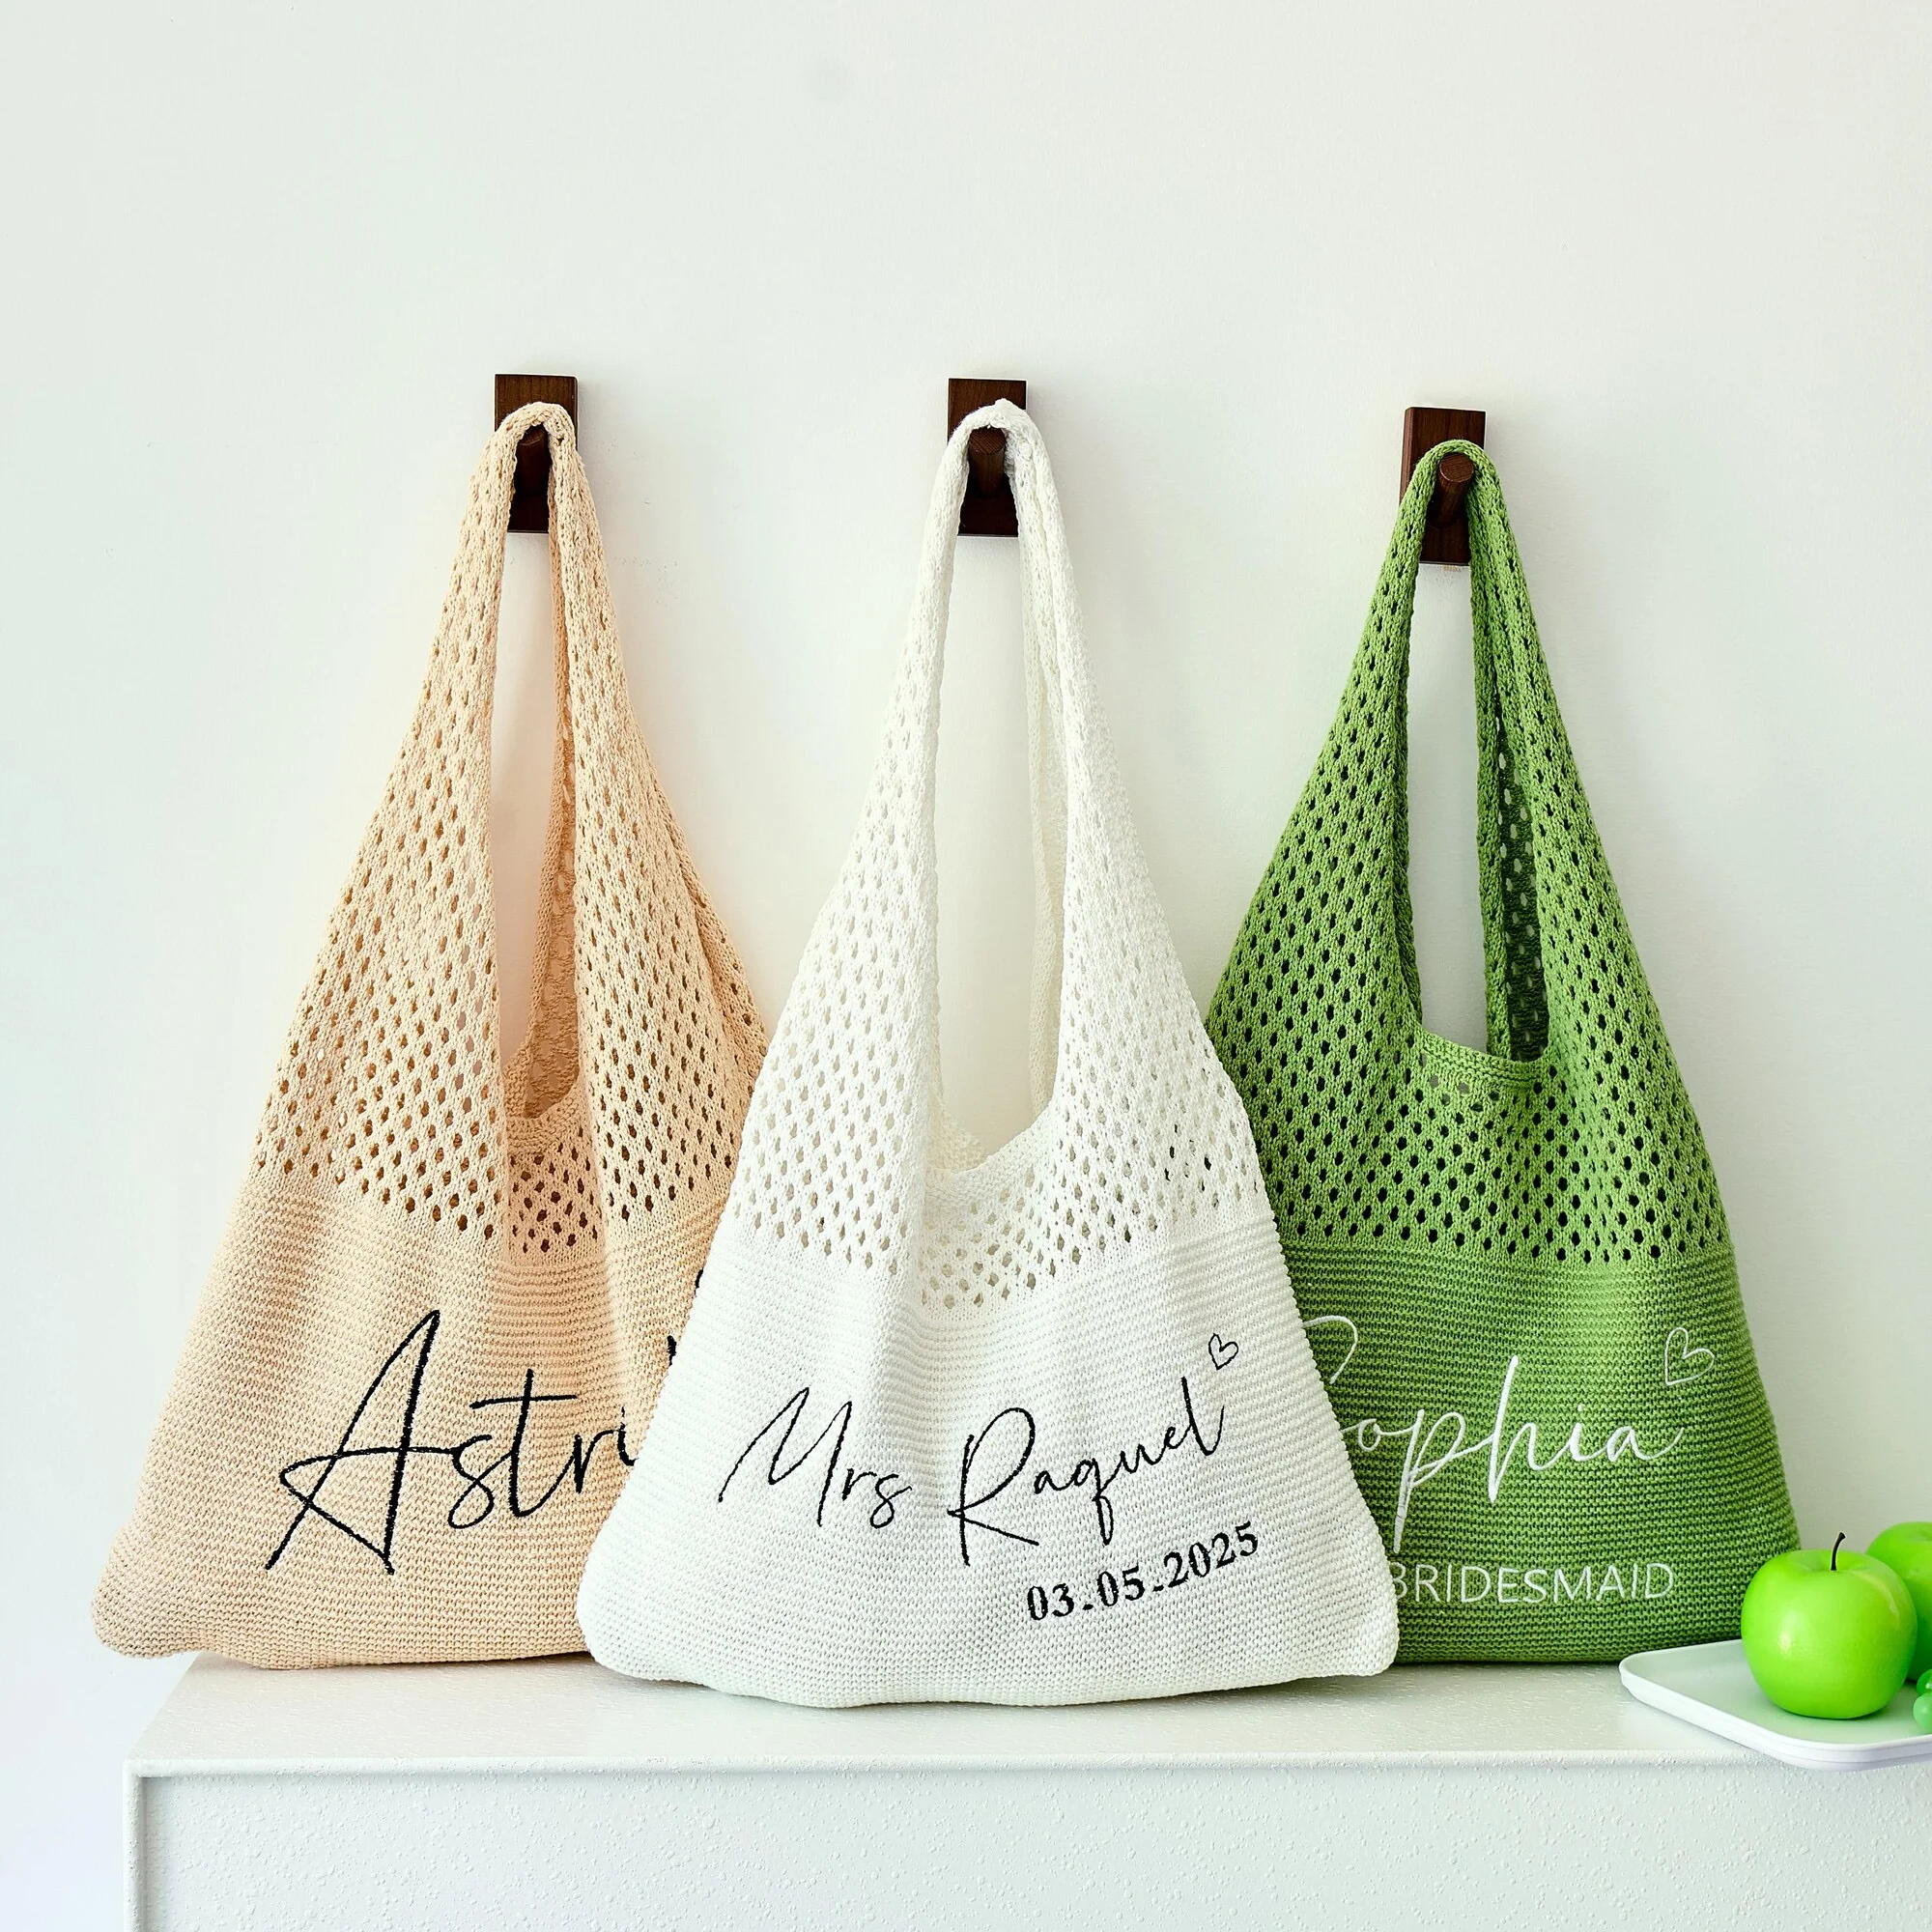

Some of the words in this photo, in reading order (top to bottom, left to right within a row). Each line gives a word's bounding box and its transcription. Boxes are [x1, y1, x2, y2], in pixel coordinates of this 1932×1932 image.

[266, 1309, 677, 1576] Astri
[718, 1386, 913, 1529] Mrs
[946, 1377, 1226, 1567] Raquel
[1025, 1520, 1259, 1621] 03.05.2025
[1389, 1561, 1675, 1605] BRIDESMAID
